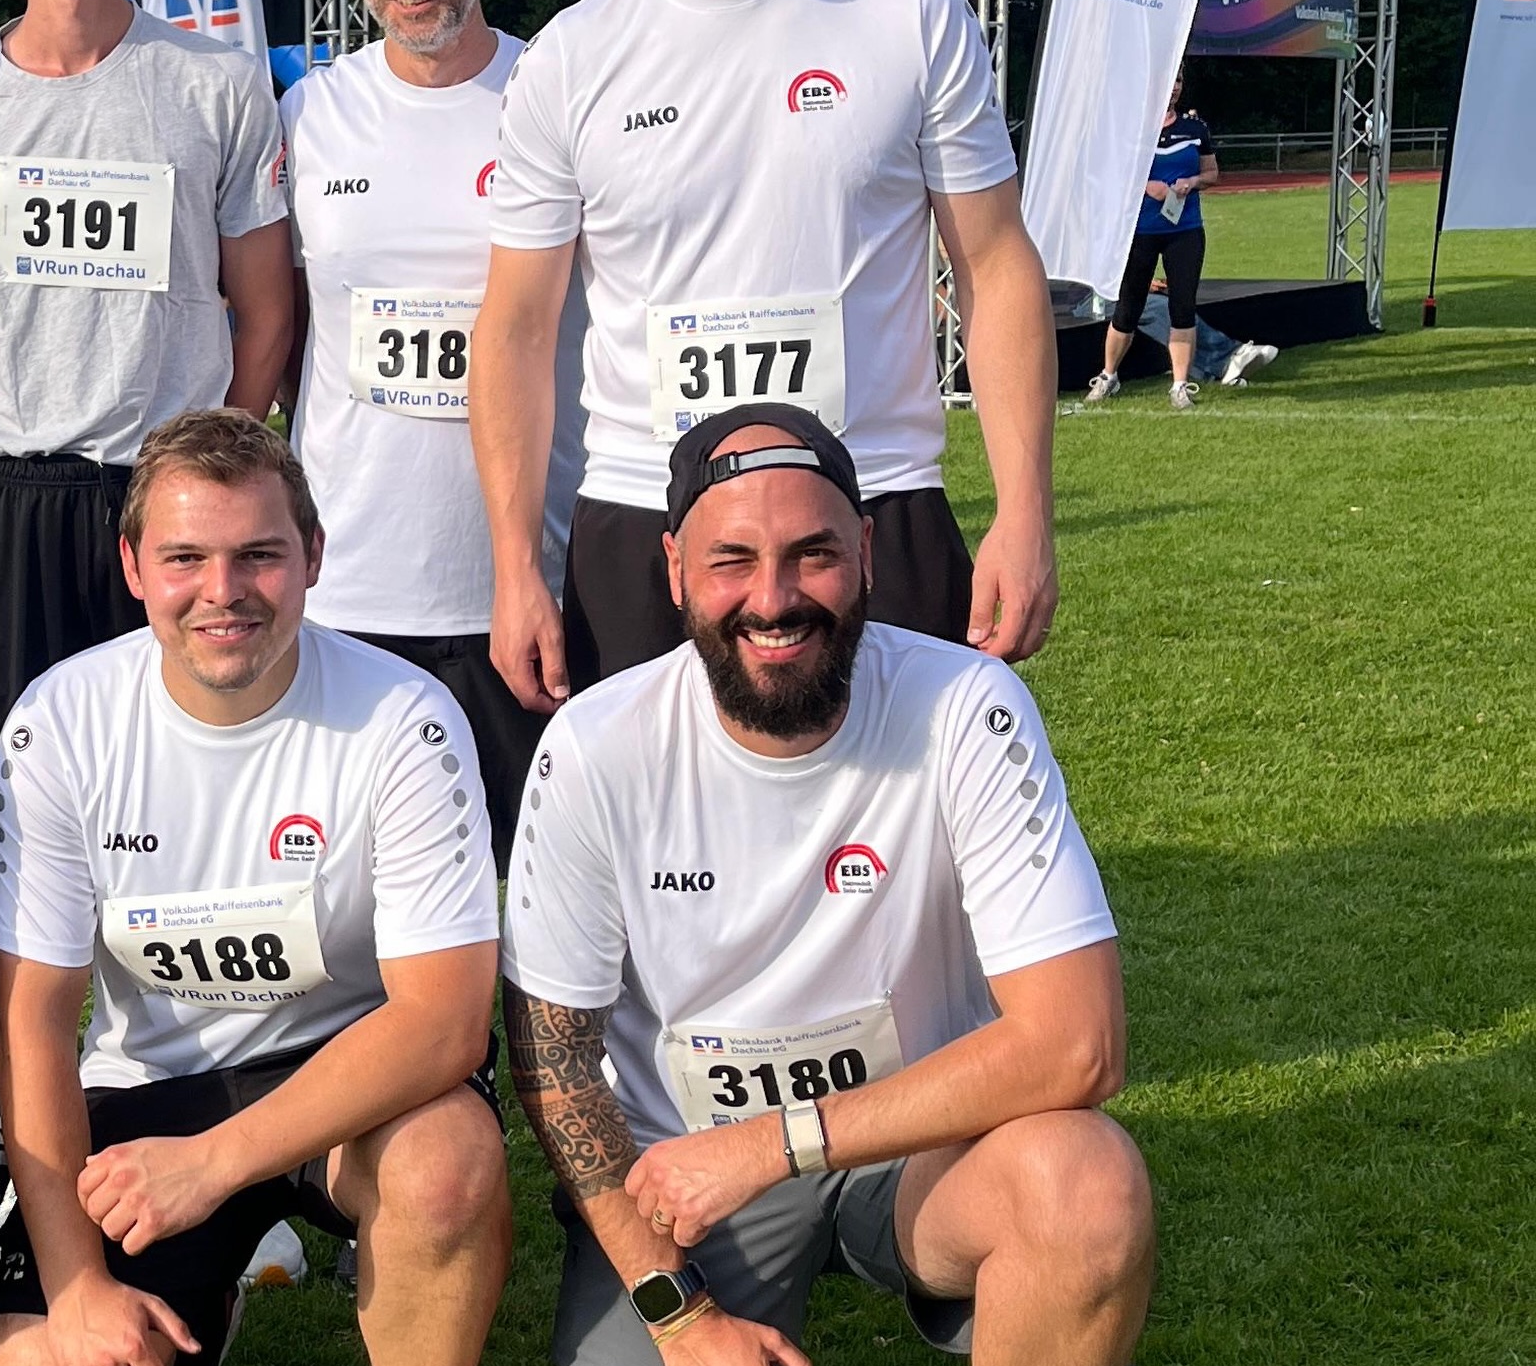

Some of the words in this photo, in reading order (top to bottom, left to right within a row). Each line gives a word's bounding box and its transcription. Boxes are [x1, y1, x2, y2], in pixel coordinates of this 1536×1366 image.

[802, 87, 832, 98] EBS
[623, 106, 679, 132] JAKO
[48, 168, 89, 178] Volksbank
[91, 171, 150, 181] Raiffeisenbank
[48, 178, 78, 186] Dachau
[79, 179, 91, 187] eG
[324, 178, 370, 195] JAKO
[23, 197, 137, 251] 3191
[33, 259, 78, 275] VRun
[83, 262, 146, 279] Dachau
[401, 300, 442, 309] Volksbank
[702, 312, 747, 322] Volksbank
[749, 307, 816, 319] Raiffeisenbank
[702, 322, 735, 332] Dachau
[737, 321, 749, 330] eG
[377, 329, 473, 379] 318
[679, 339, 812, 399] 3177
[387, 391, 432, 405] VRun
[437, 392, 468, 407] Dac
[103, 832, 159, 853] JAKO
[284, 834, 315, 846] EBS
[841, 864, 870, 877] EBS
[650, 871, 715, 892] JAKO
[162, 904, 210, 915] Volksbank
[213, 897, 283, 912] Raiffeisenbank
[163, 916, 198, 927] Dachau
[200, 915, 214, 924] eG
[143, 933, 291, 983] 3188
[175, 989, 227, 1001] VRun
[232, 989, 307, 1002] Dachau
[728, 1037, 782, 1046] Volksbank
[731, 1045, 770, 1055] Dachau
[772, 1045, 787, 1053] eG
[708, 1048, 867, 1107] 3180
